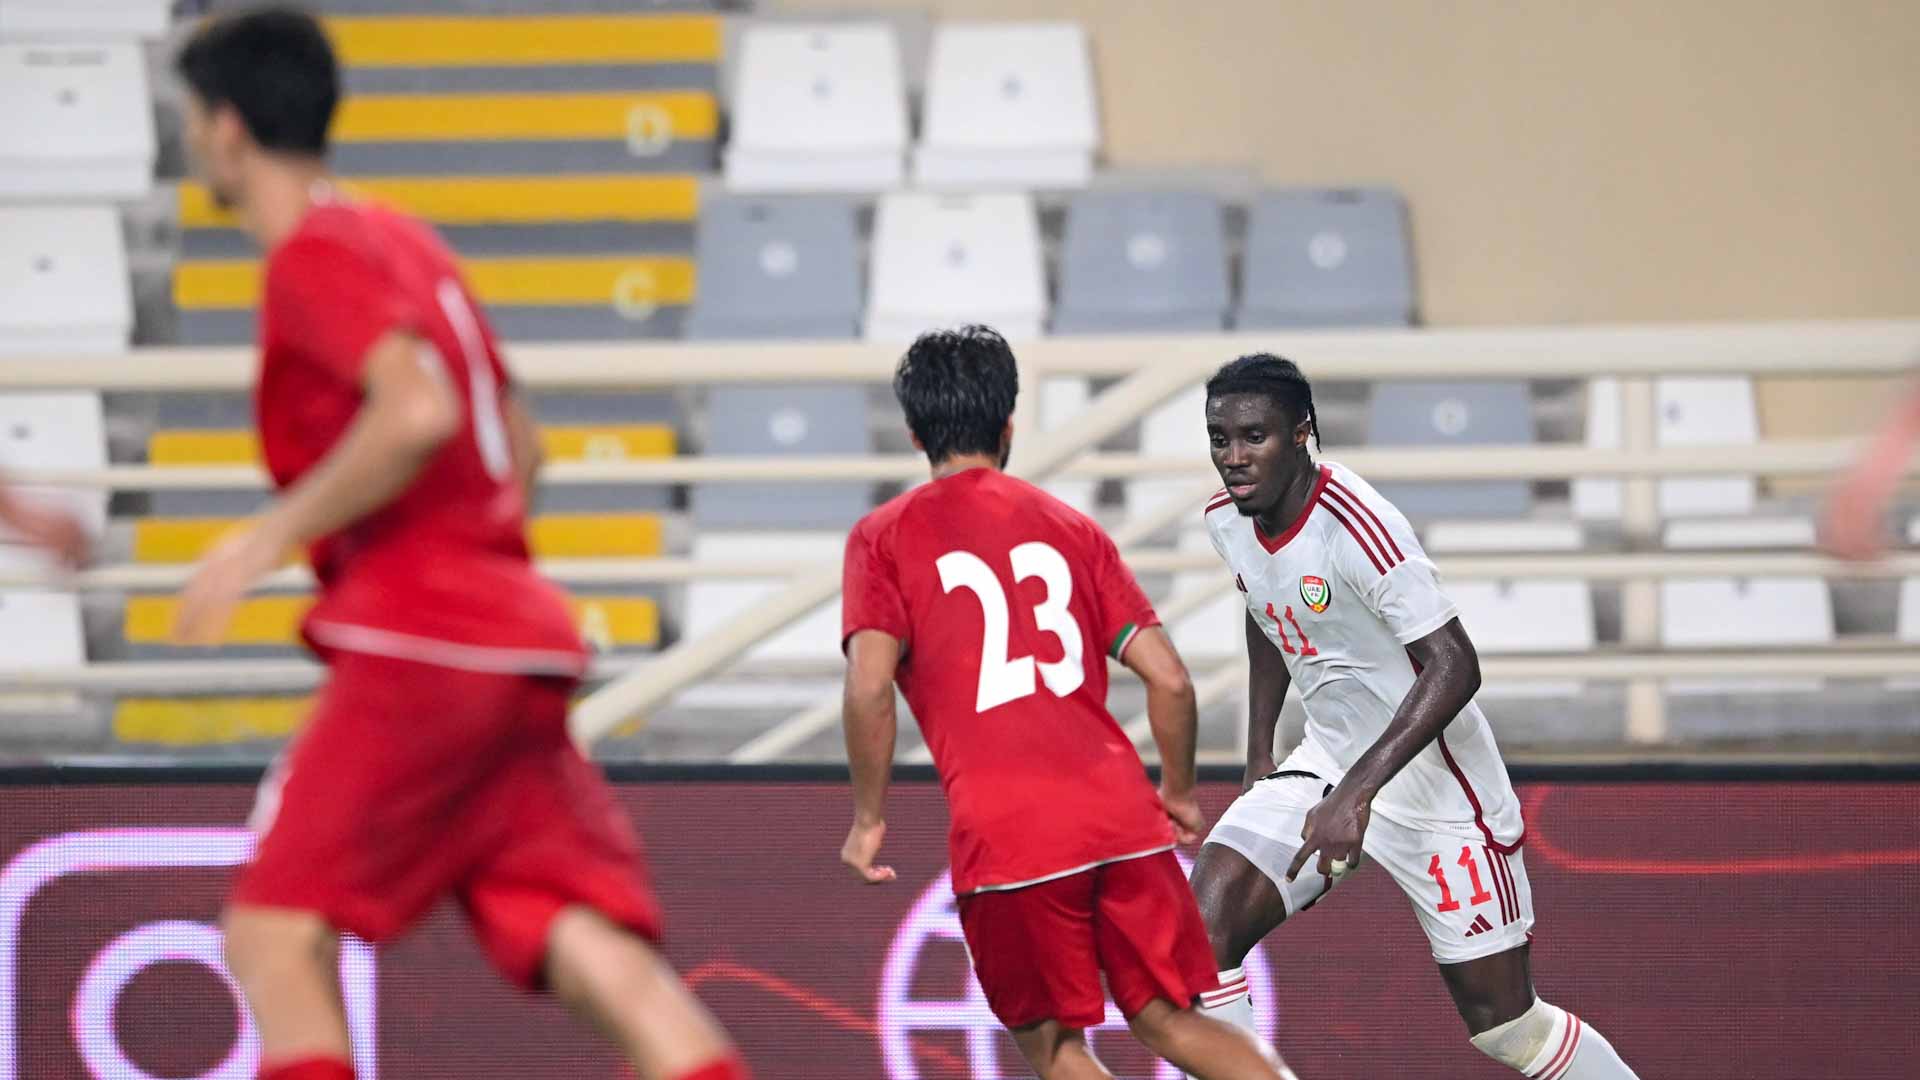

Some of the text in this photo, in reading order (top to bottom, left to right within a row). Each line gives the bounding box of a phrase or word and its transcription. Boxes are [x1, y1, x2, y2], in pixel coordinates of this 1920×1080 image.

[626, 104, 673, 157] D
[613, 267, 659, 320] C
[935, 541, 1085, 713] 23
[1265, 603, 1318, 656] 11
[1427, 845, 1493, 912] 11
